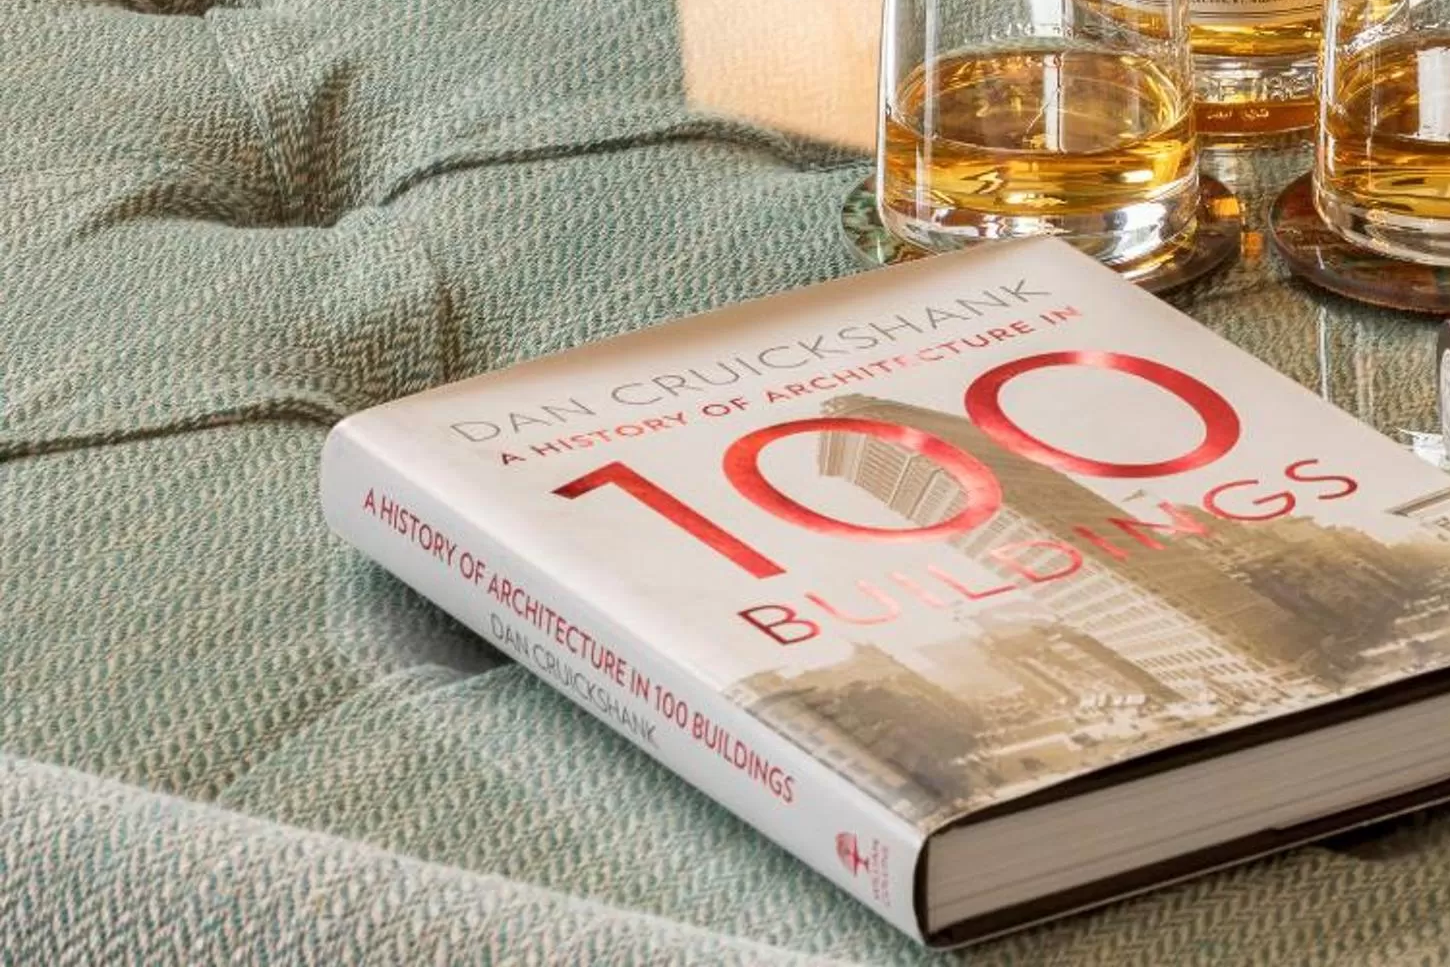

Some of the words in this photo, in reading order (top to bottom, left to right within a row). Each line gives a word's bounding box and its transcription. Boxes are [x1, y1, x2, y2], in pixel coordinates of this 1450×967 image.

[450, 396, 597, 443] DAN
[610, 278, 1052, 406] CRUICKSHANK
[500, 451, 526, 466] A
[530, 411, 688, 458] HISTORY
[701, 395, 750, 417] OF
[764, 320, 1035, 404] ARCHITECTURE
[1040, 304, 1083, 326] IN
[552, 350, 1241, 579] 100
[737, 458, 1358, 646] BUILDINGS
[363, 487, 376, 516] A
[380, 496, 459, 567] HISTORY
[459, 551, 486, 586] OF
[486, 574, 627, 687] ARCHITECTURE
[630, 666, 651, 703] IN
[654, 685, 689, 729] 100
[691, 711, 796, 804] BUILDINGS
[489, 612, 530, 657] DAN
[531, 643, 660, 750] CRUICKSHANK
